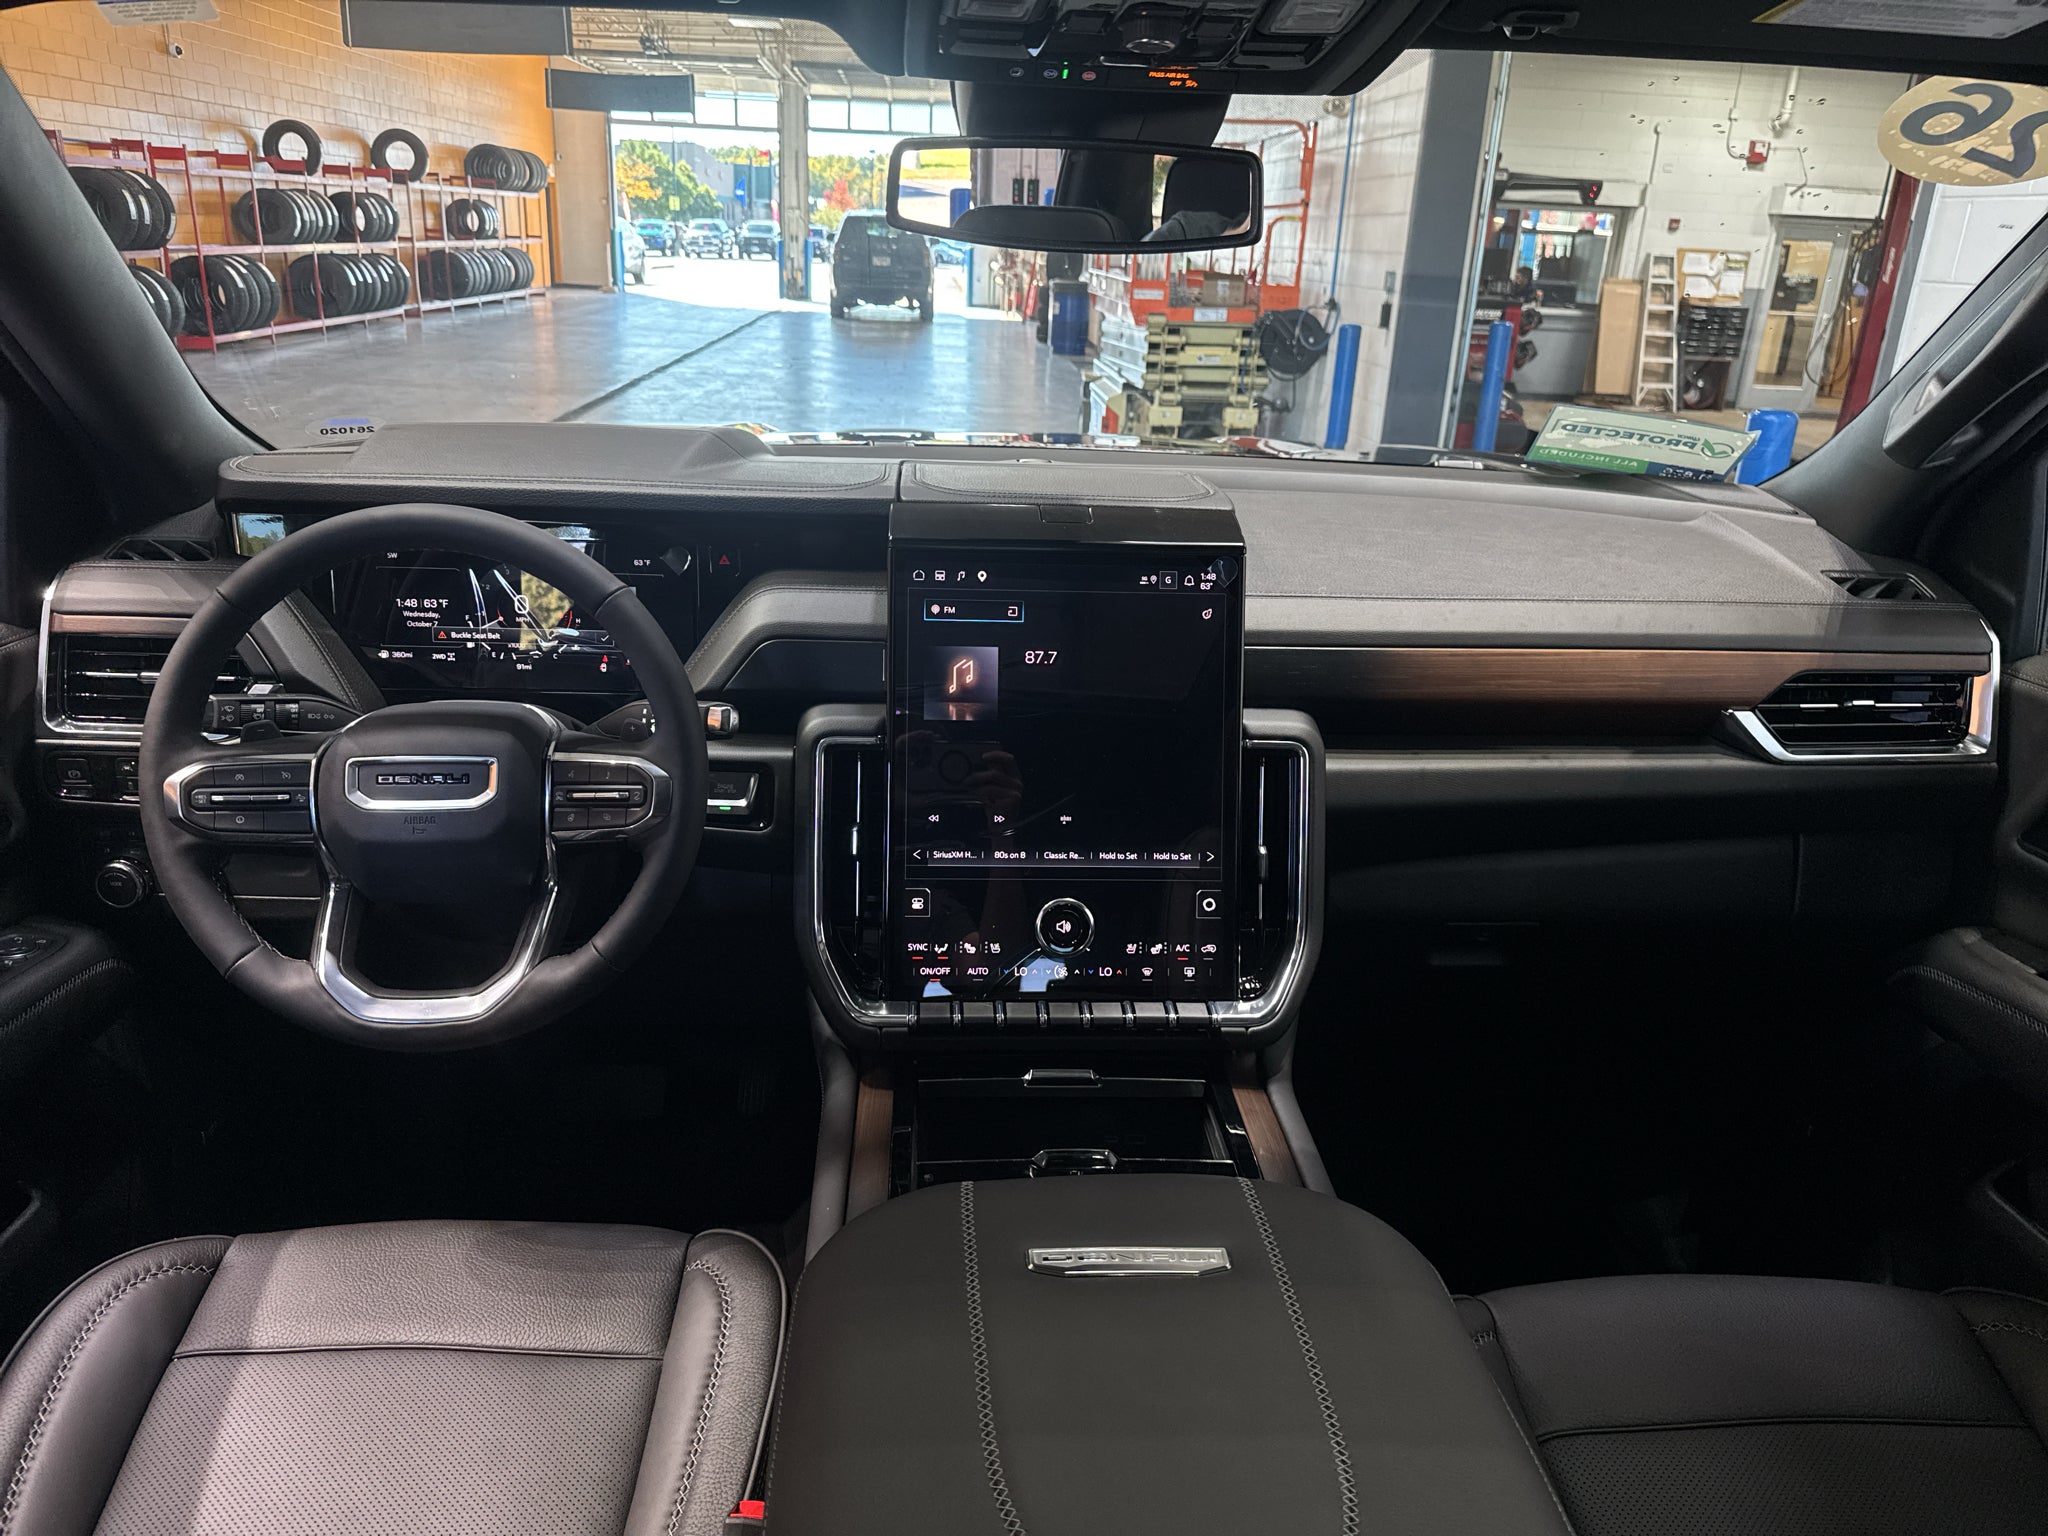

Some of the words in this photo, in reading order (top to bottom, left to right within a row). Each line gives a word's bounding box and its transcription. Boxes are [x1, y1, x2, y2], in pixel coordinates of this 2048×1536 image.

[1165, 576, 1172, 584] G
[1200, 573, 1217, 581] 1:48
[396, 599, 418, 608] 1:48
[423, 599, 437, 608] 63
[943, 606, 956, 614] FM
[1025, 650, 1057, 664] 87.7
[376, 774, 469, 785] DENALI
[403, 816, 436, 825] AIRBAG
[933, 850, 964, 859] SiriusXM
[994, 851, 1009, 859] 80s
[1043, 851, 1067, 859] Classic
[1099, 852, 1115, 860] Hold
[1117, 852, 1125, 860] to
[1126, 852, 1138, 860] Set
[1153, 852, 1169, 860] Hold
[1171, 852, 1179, 860] to
[1180, 852, 1192, 860] Set
[907, 943, 928, 952] SYNC
[1175, 944, 1190, 952] A/C
[919, 967, 951, 976] ON/OFF
[966, 967, 989, 976] AUTO
[1014, 967, 1028, 977] LO
[1098, 967, 1112, 977] LO
